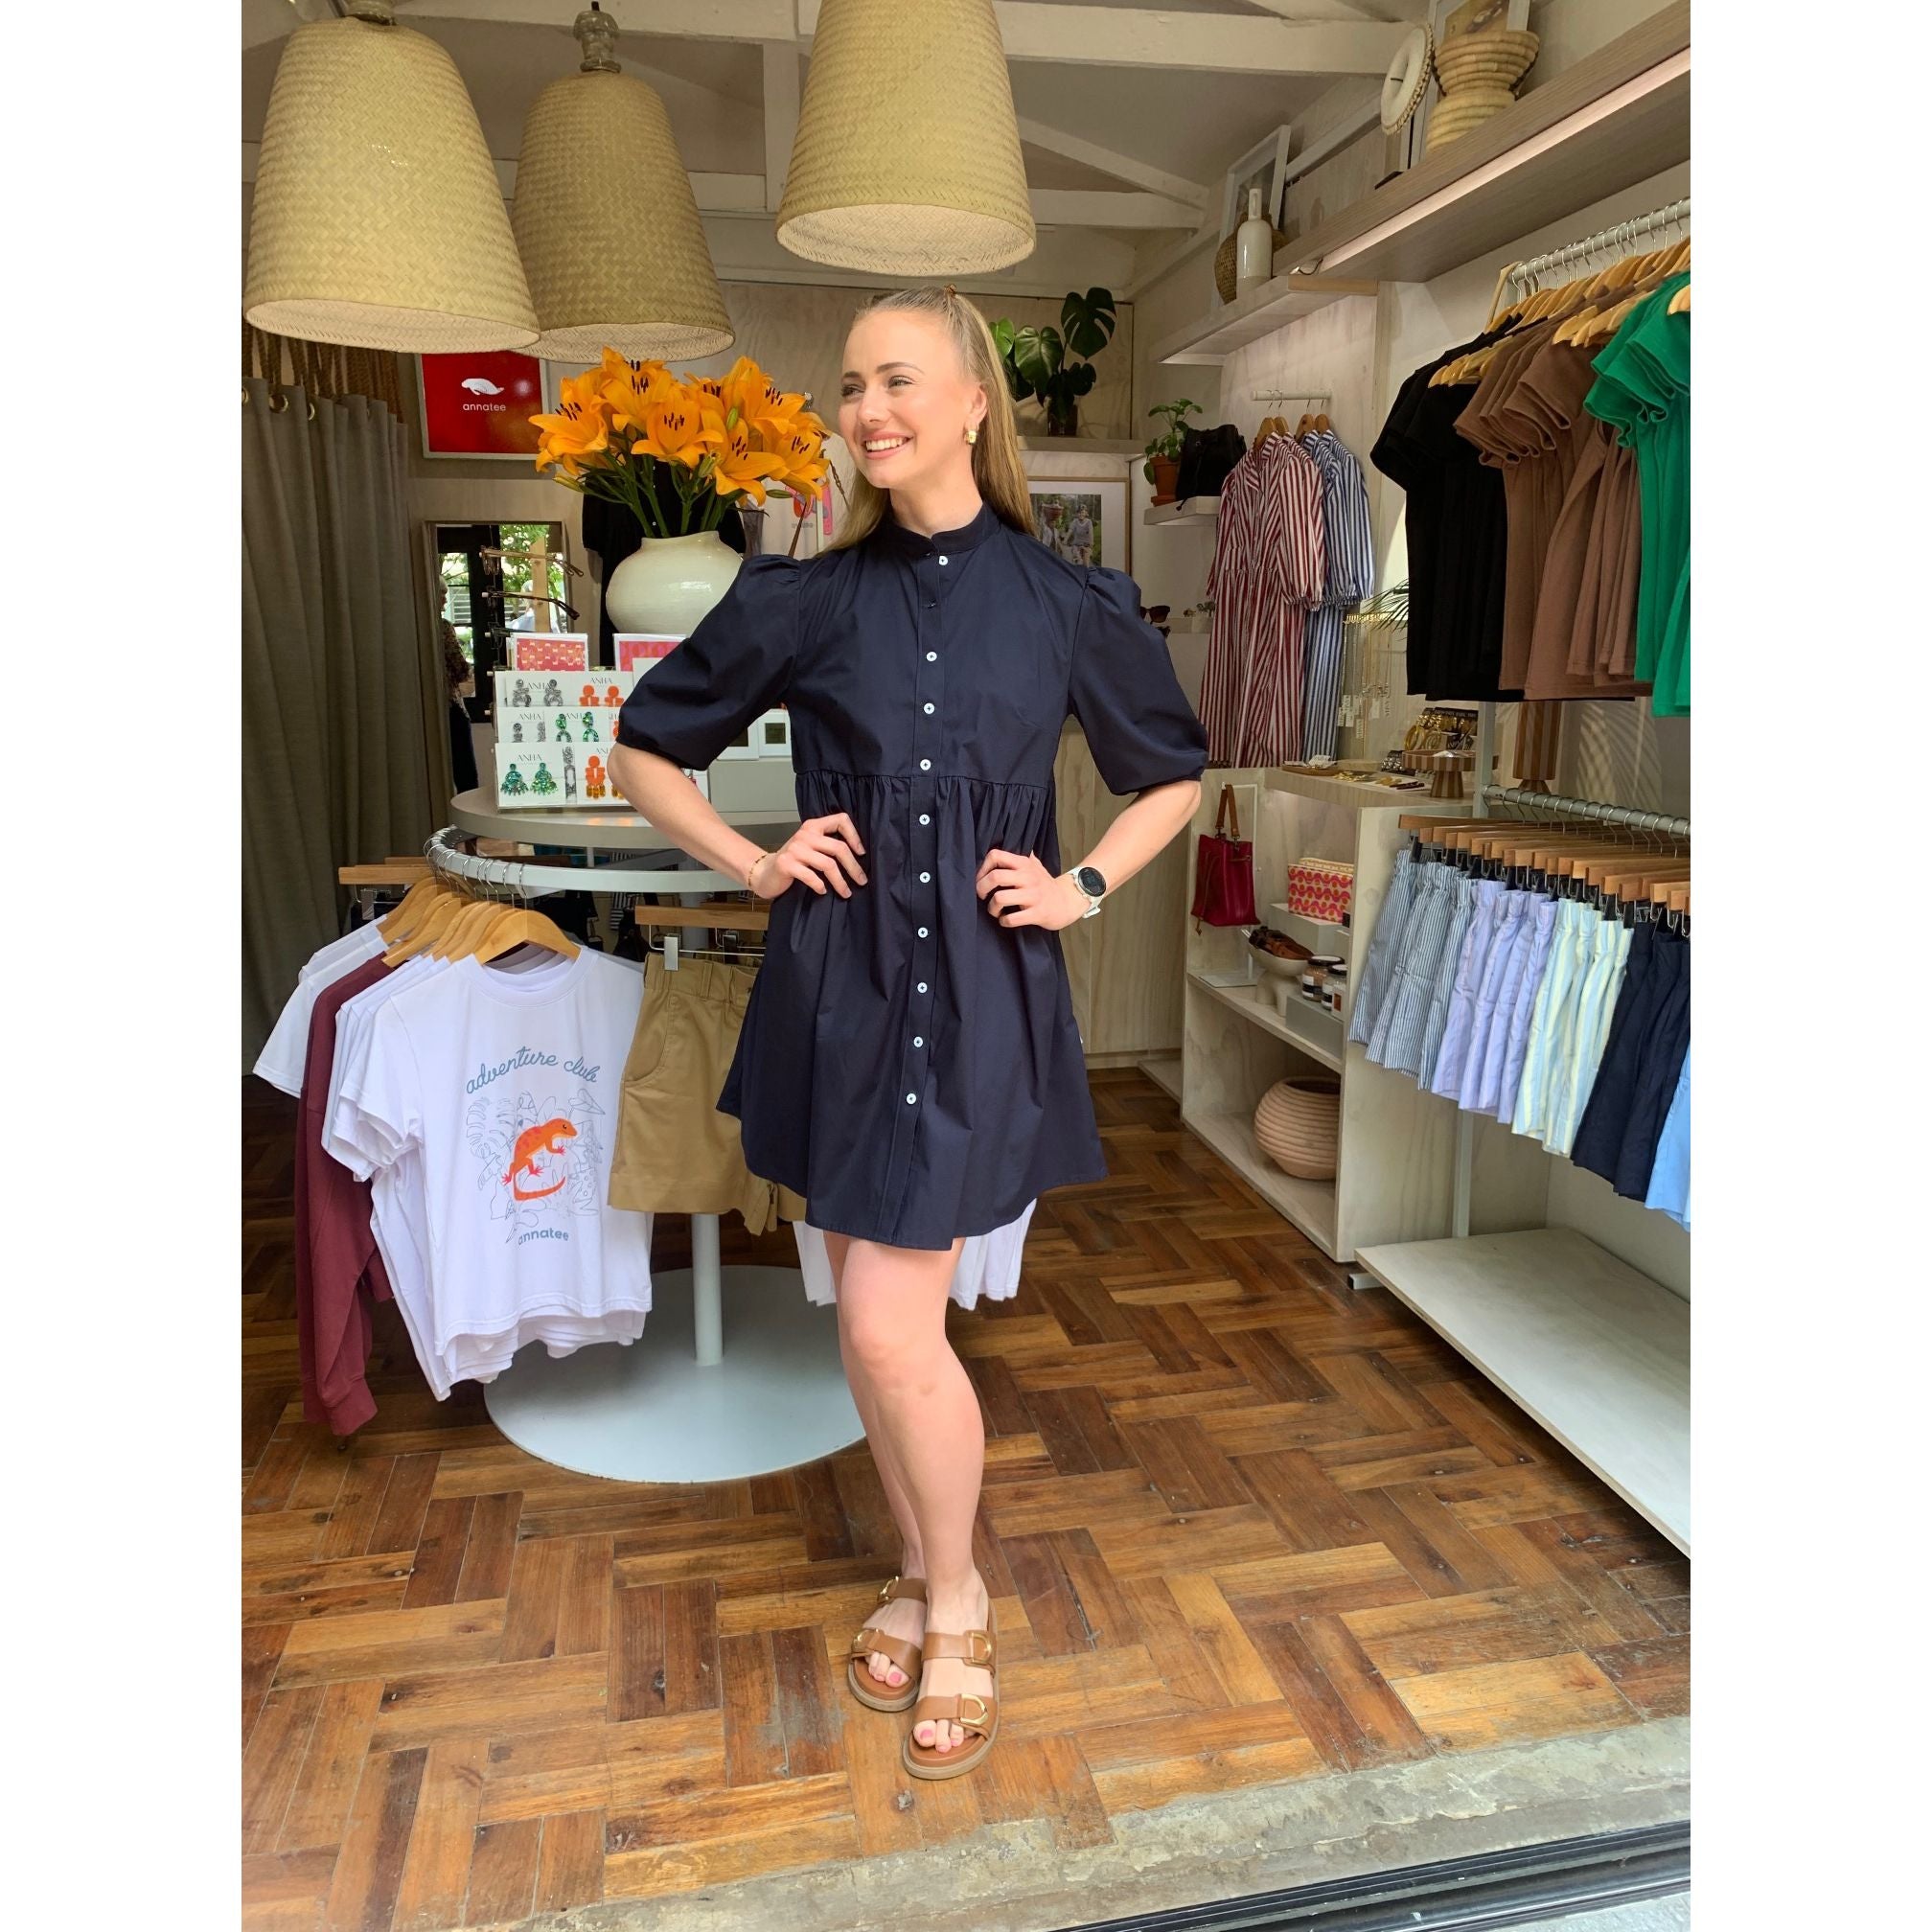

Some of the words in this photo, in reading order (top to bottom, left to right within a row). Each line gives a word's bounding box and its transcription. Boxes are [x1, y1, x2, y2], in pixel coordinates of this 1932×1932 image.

[462, 402, 507, 411] annatee
[466, 1046, 559, 1094] adventure
[564, 1056, 601, 1083] club
[518, 1227, 569, 1245] annatee
